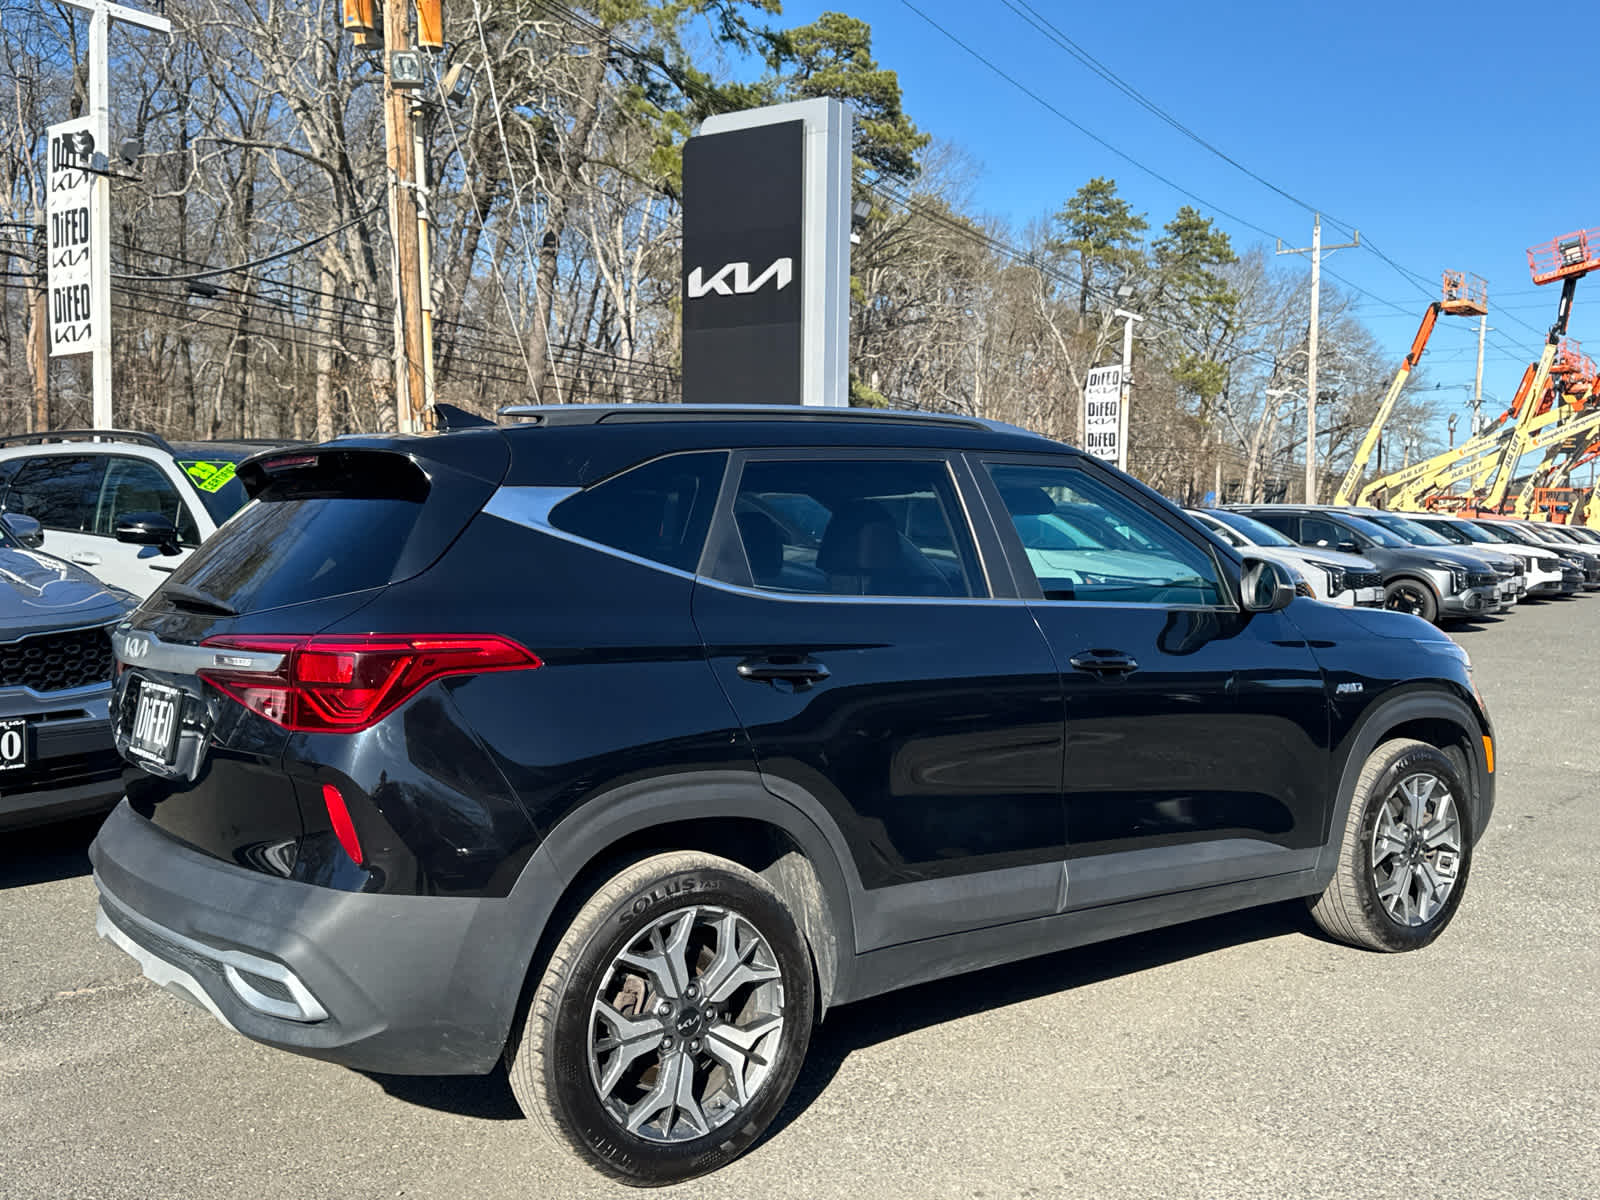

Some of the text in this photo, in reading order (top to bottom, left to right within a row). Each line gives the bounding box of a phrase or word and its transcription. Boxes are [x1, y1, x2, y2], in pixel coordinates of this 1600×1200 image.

[52, 207, 89, 248] DiFEO
[52, 247, 89, 268] KIA
[687, 257, 793, 298] KIA
[54, 283, 91, 324] DiFEO
[54, 323, 92, 344] KIA
[124, 637, 149, 657] KIA
[619, 878, 696, 925] SOLUS
